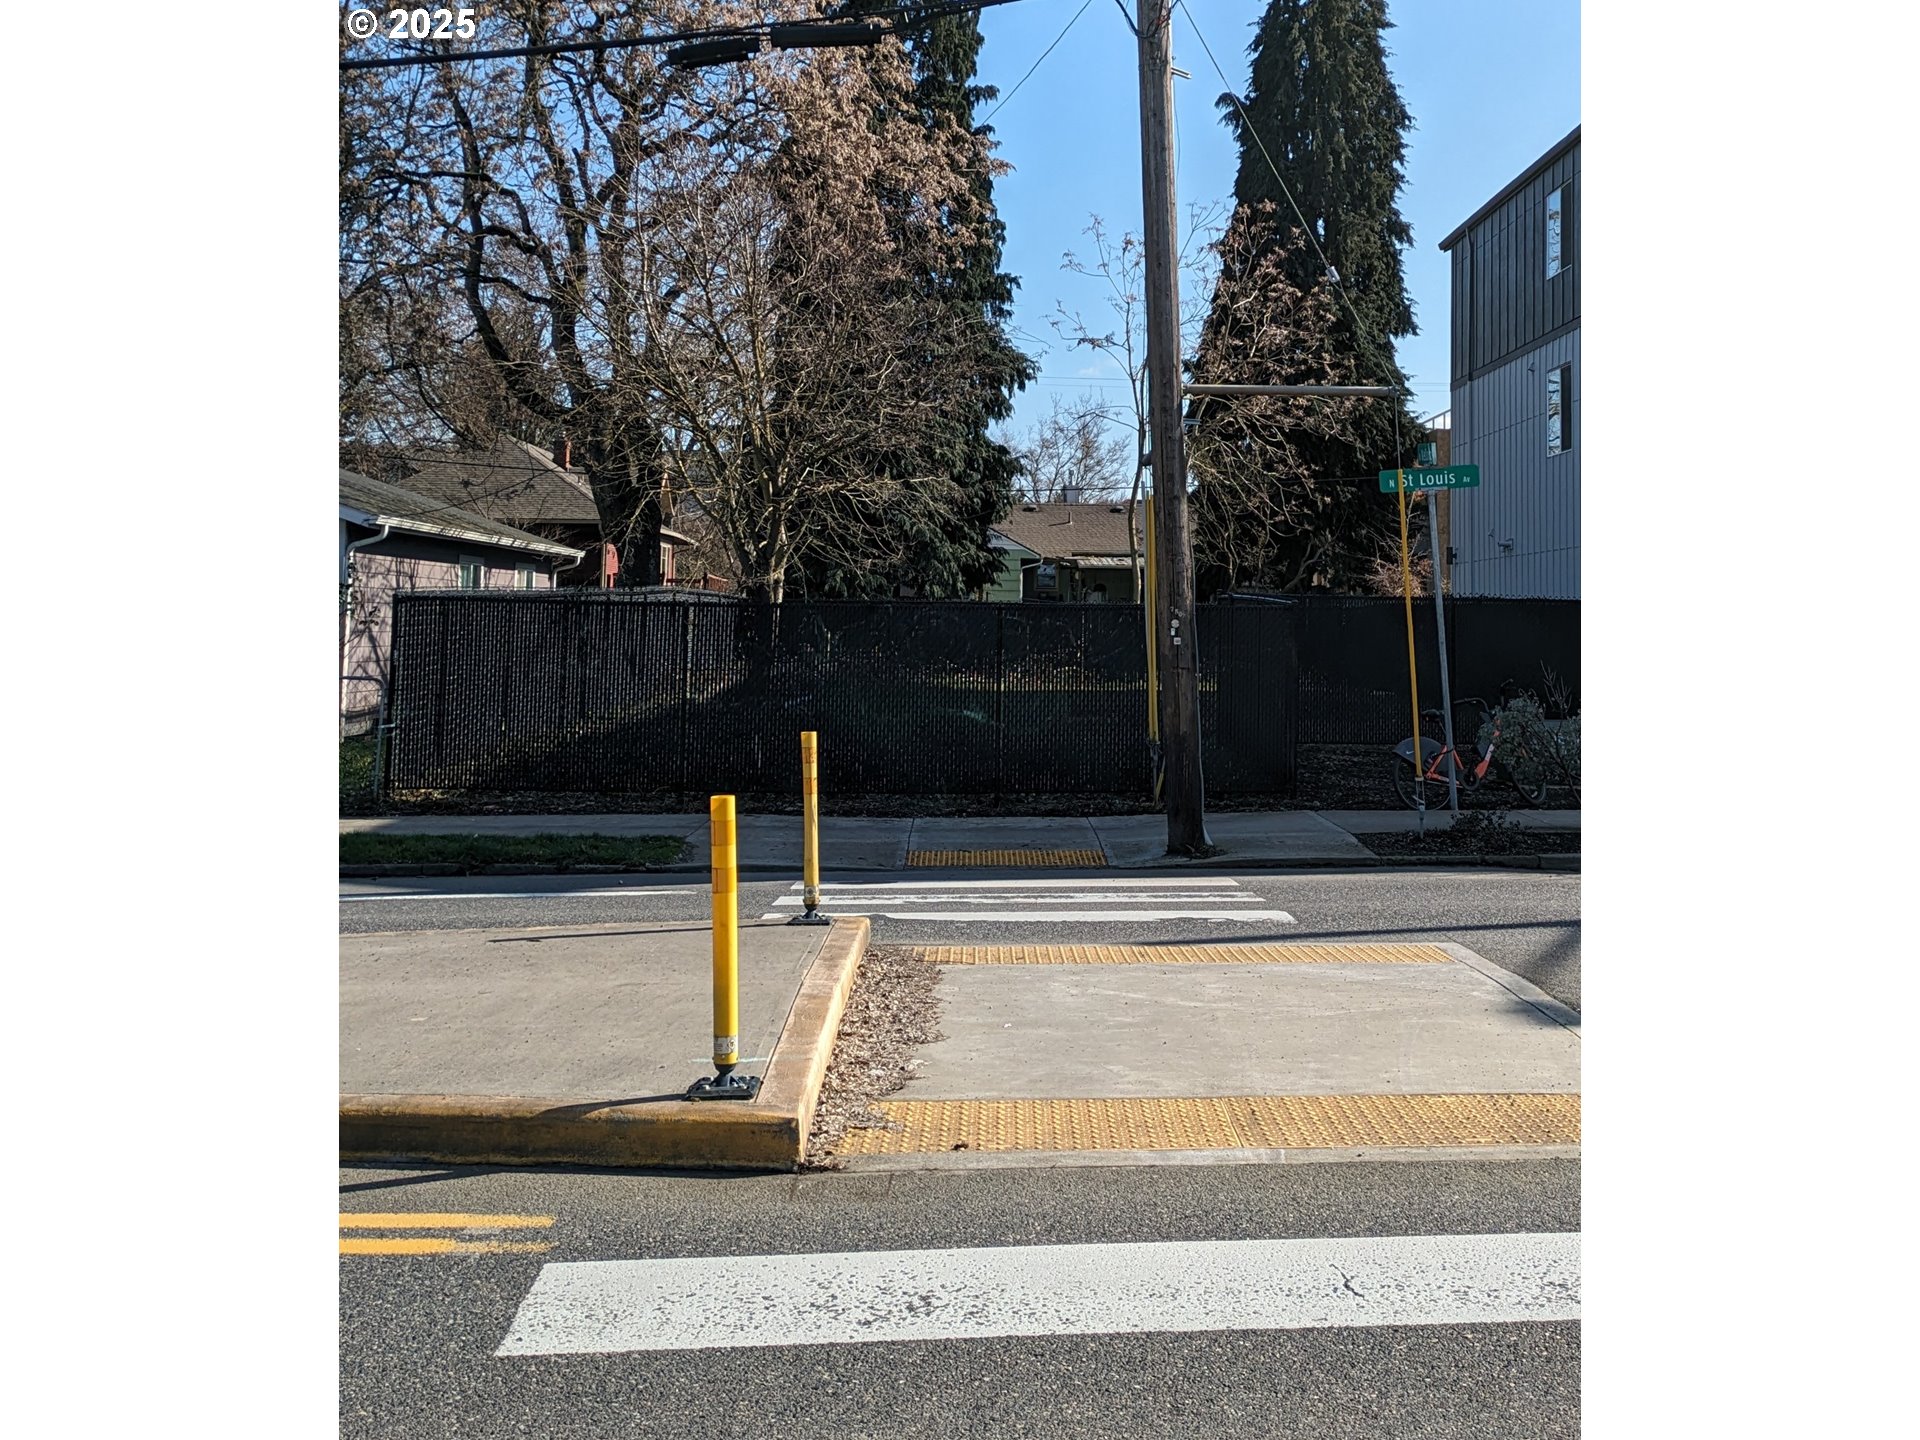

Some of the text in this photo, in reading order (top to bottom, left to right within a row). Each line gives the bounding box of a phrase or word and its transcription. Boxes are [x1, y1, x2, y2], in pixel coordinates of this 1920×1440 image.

[1389, 479, 1395, 488] N
[1402, 474, 1414, 487] St
[1420, 471, 1456, 486] Louis
